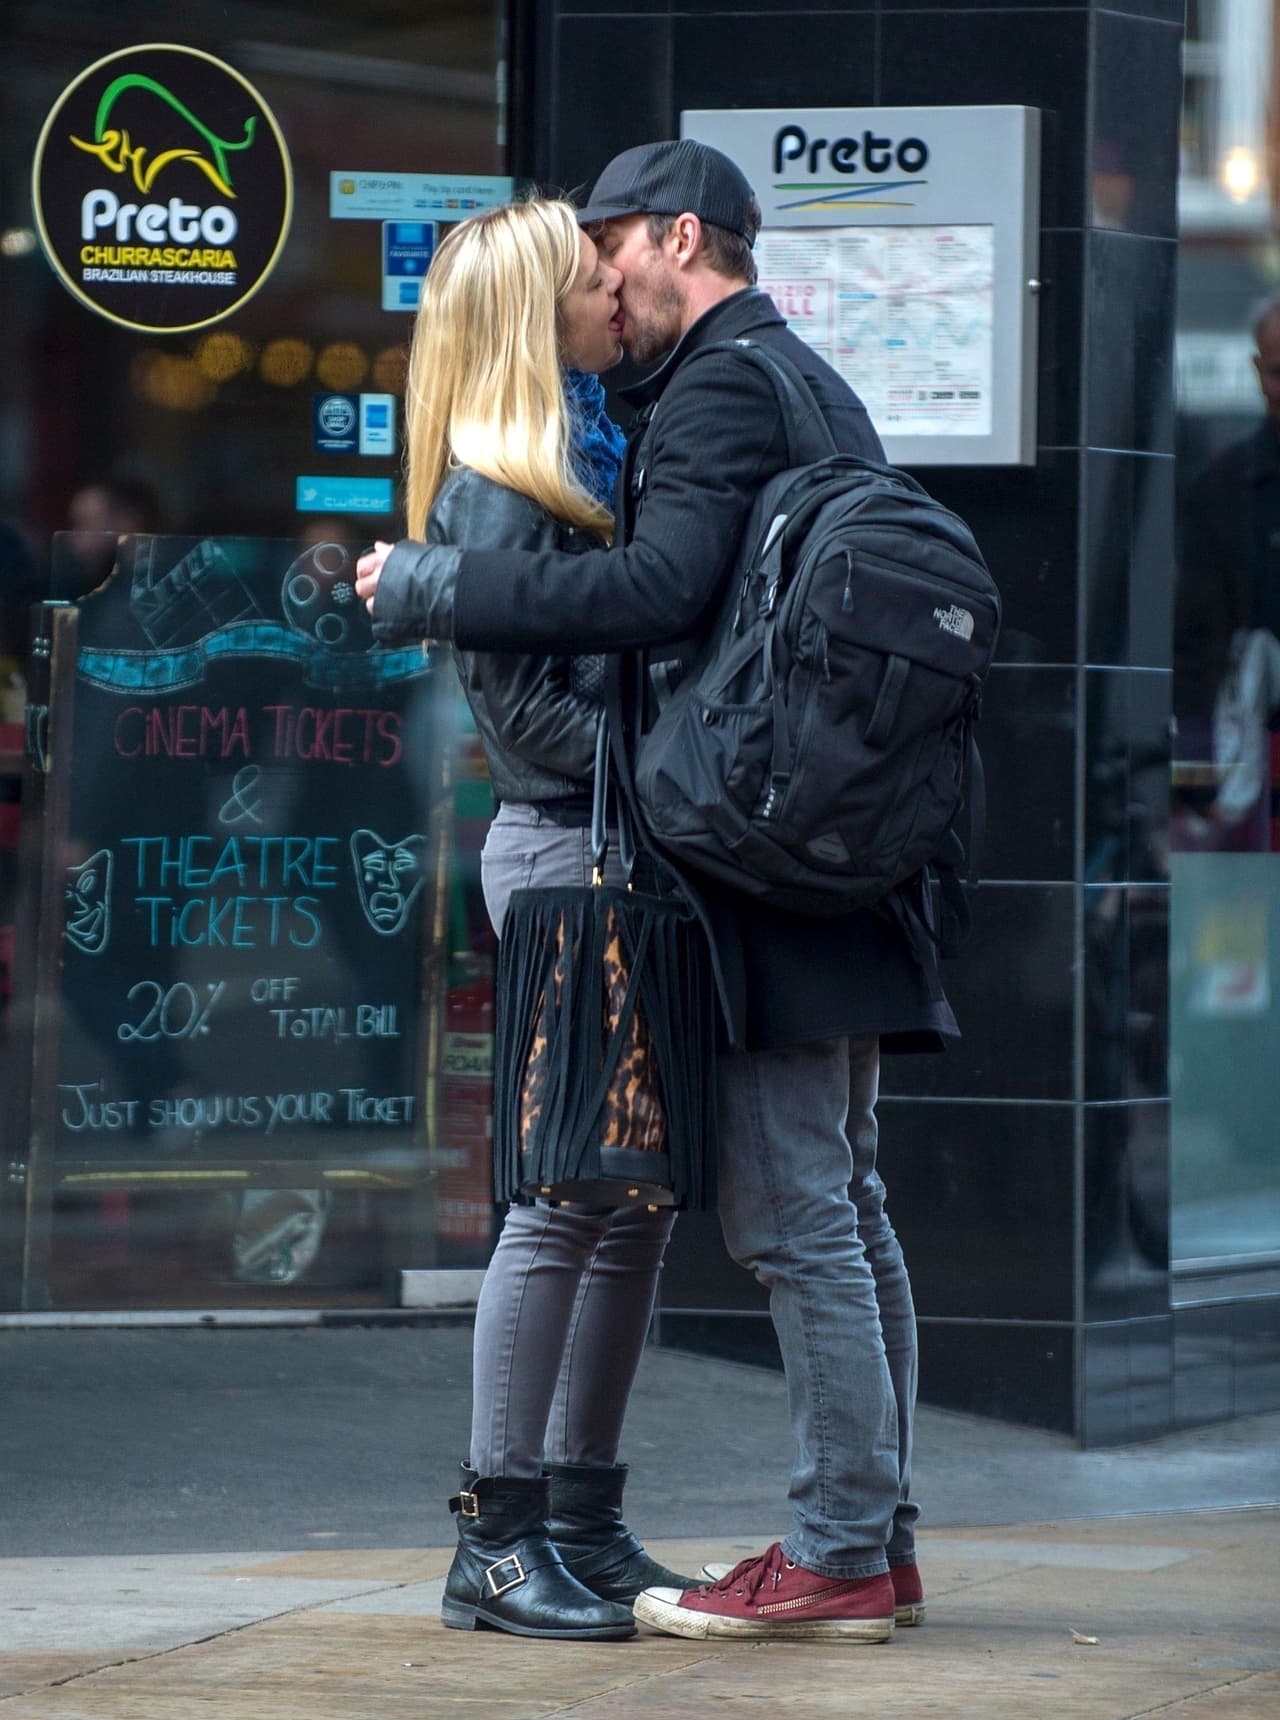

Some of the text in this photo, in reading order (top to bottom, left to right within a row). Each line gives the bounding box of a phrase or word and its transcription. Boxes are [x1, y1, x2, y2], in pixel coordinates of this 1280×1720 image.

[774, 125, 929, 173] Preto
[81, 189, 238, 245] Preto
[81, 246, 238, 268] CHURRASCARIA
[83, 268, 237, 285] BRAZILIAN STEAKHOUSE
[933, 607, 961, 626] NORTH
[939, 618, 961, 634] FACE
[950, 604, 965, 618] THE
[218, 764, 263, 824] &
[120, 836, 341, 888] THEATRE
[117, 977, 300, 1041] 20% OFF
